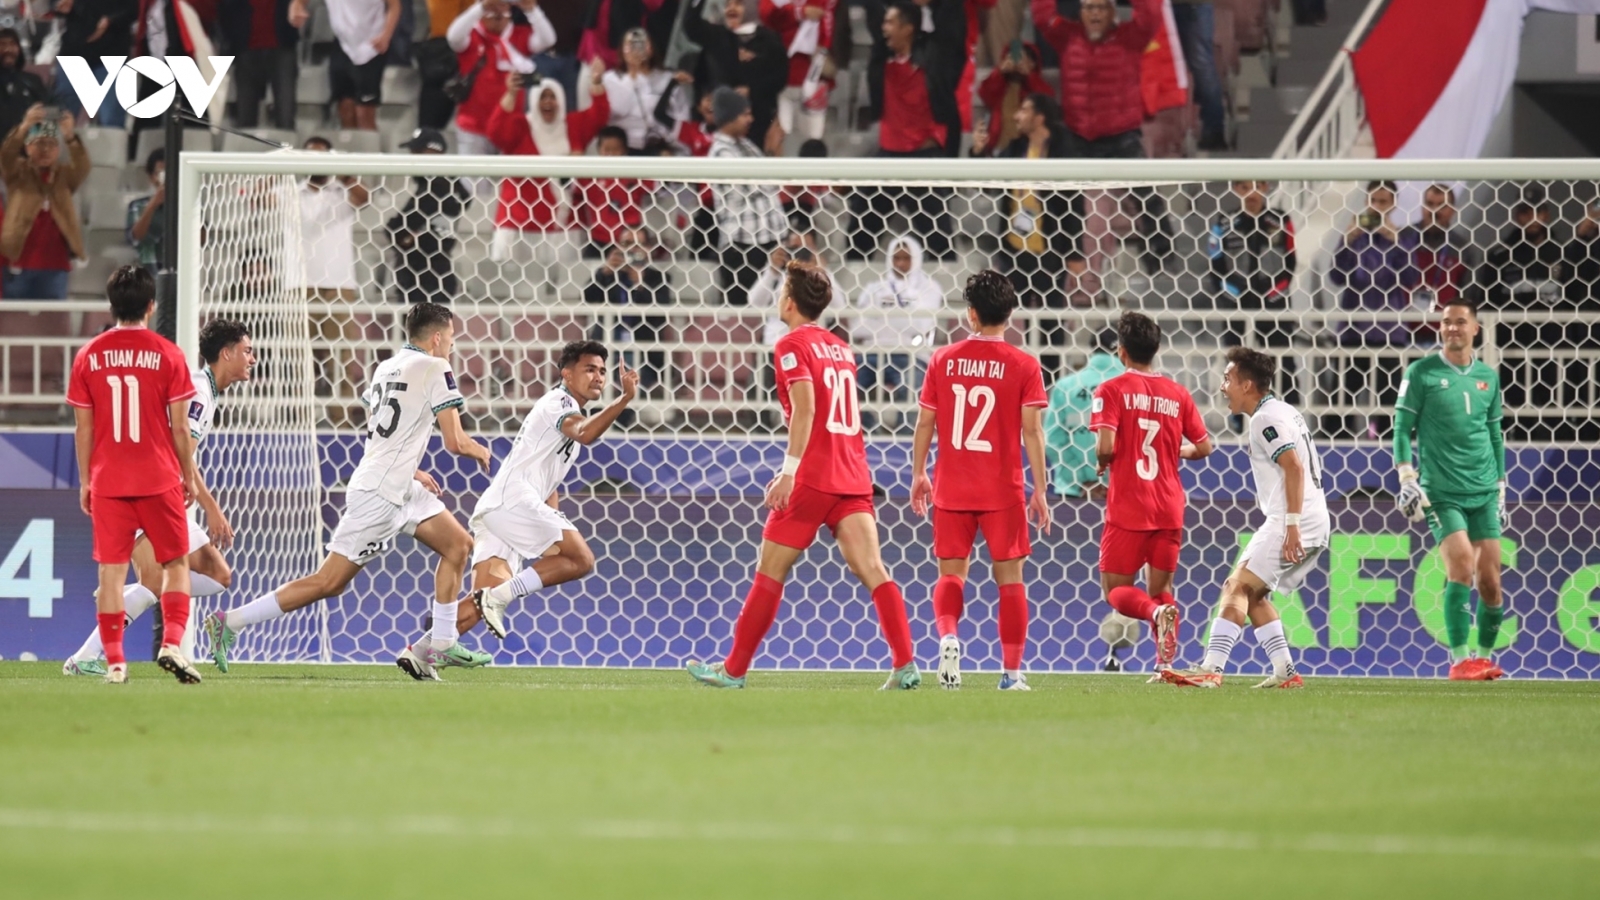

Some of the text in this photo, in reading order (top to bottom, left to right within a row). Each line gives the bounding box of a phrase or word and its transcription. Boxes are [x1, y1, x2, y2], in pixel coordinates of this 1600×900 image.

[88, 349, 161, 371] N. TUAN ANH
[946, 358, 1005, 379] P. TUAN TAI
[106, 374, 140, 443] 11
[824, 367, 861, 436] 20
[951, 383, 996, 453] 12
[1132, 393, 1152, 412] MINH
[1152, 396, 1180, 418] TRONG
[1463, 391, 1472, 415] 1
[1136, 417, 1161, 481] 3
[0, 518, 64, 618] 4
[1201, 533, 1518, 652] AFC
